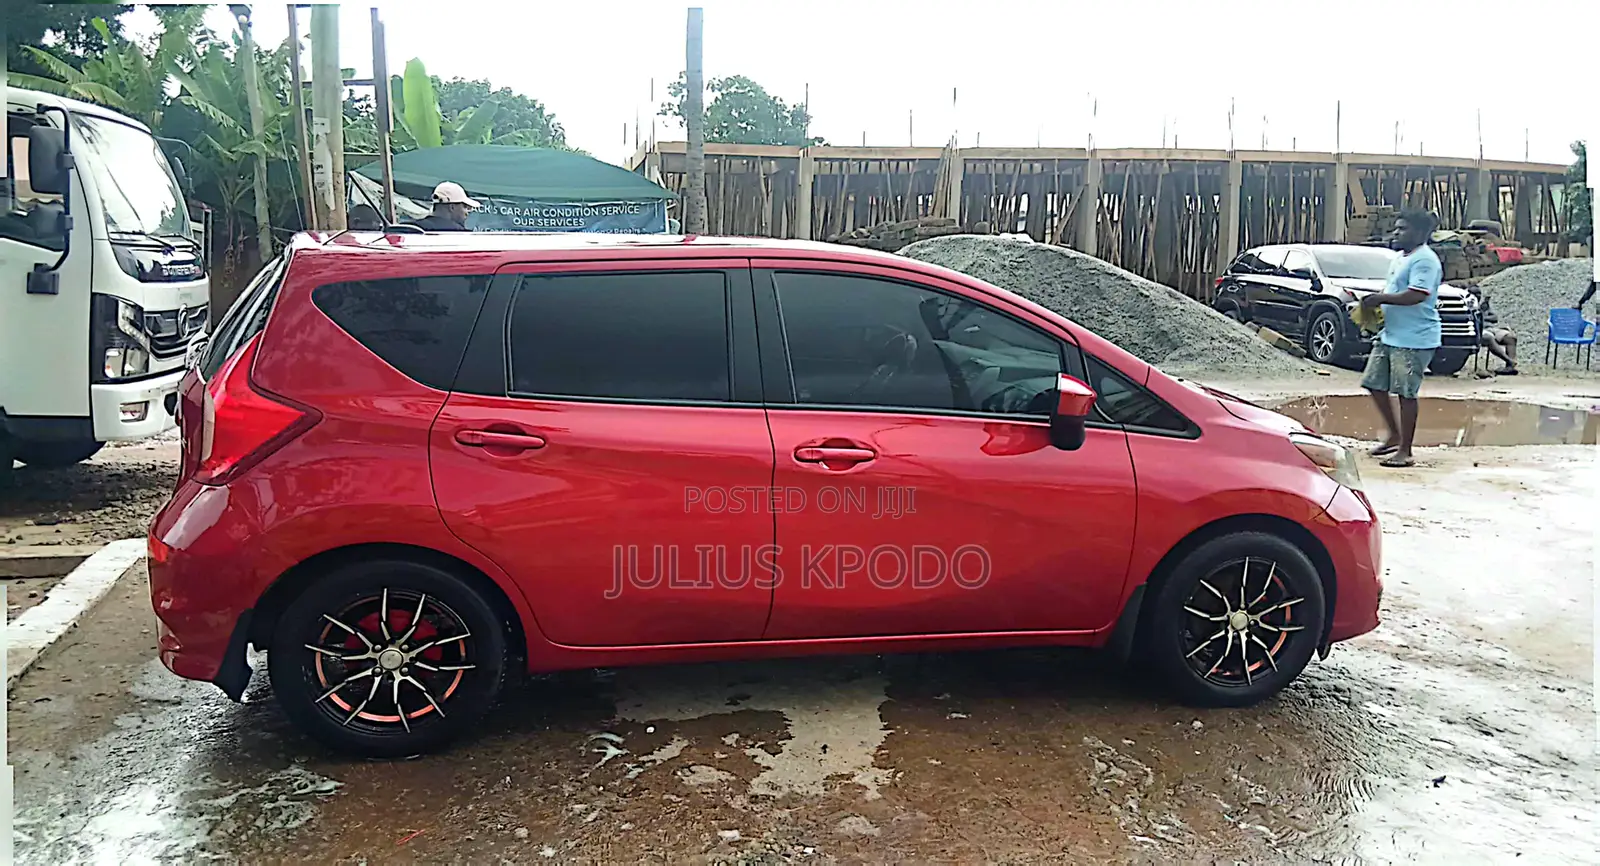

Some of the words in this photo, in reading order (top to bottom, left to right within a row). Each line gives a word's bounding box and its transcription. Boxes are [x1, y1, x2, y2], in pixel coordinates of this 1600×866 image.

[500, 206, 521, 216] CAR
[523, 207, 541, 217] AIR
[542, 207, 599, 218] CONDITION
[601, 205, 640, 216] SERVICE
[513, 217, 535, 226] OUR
[537, 217, 585, 227] SERVICES
